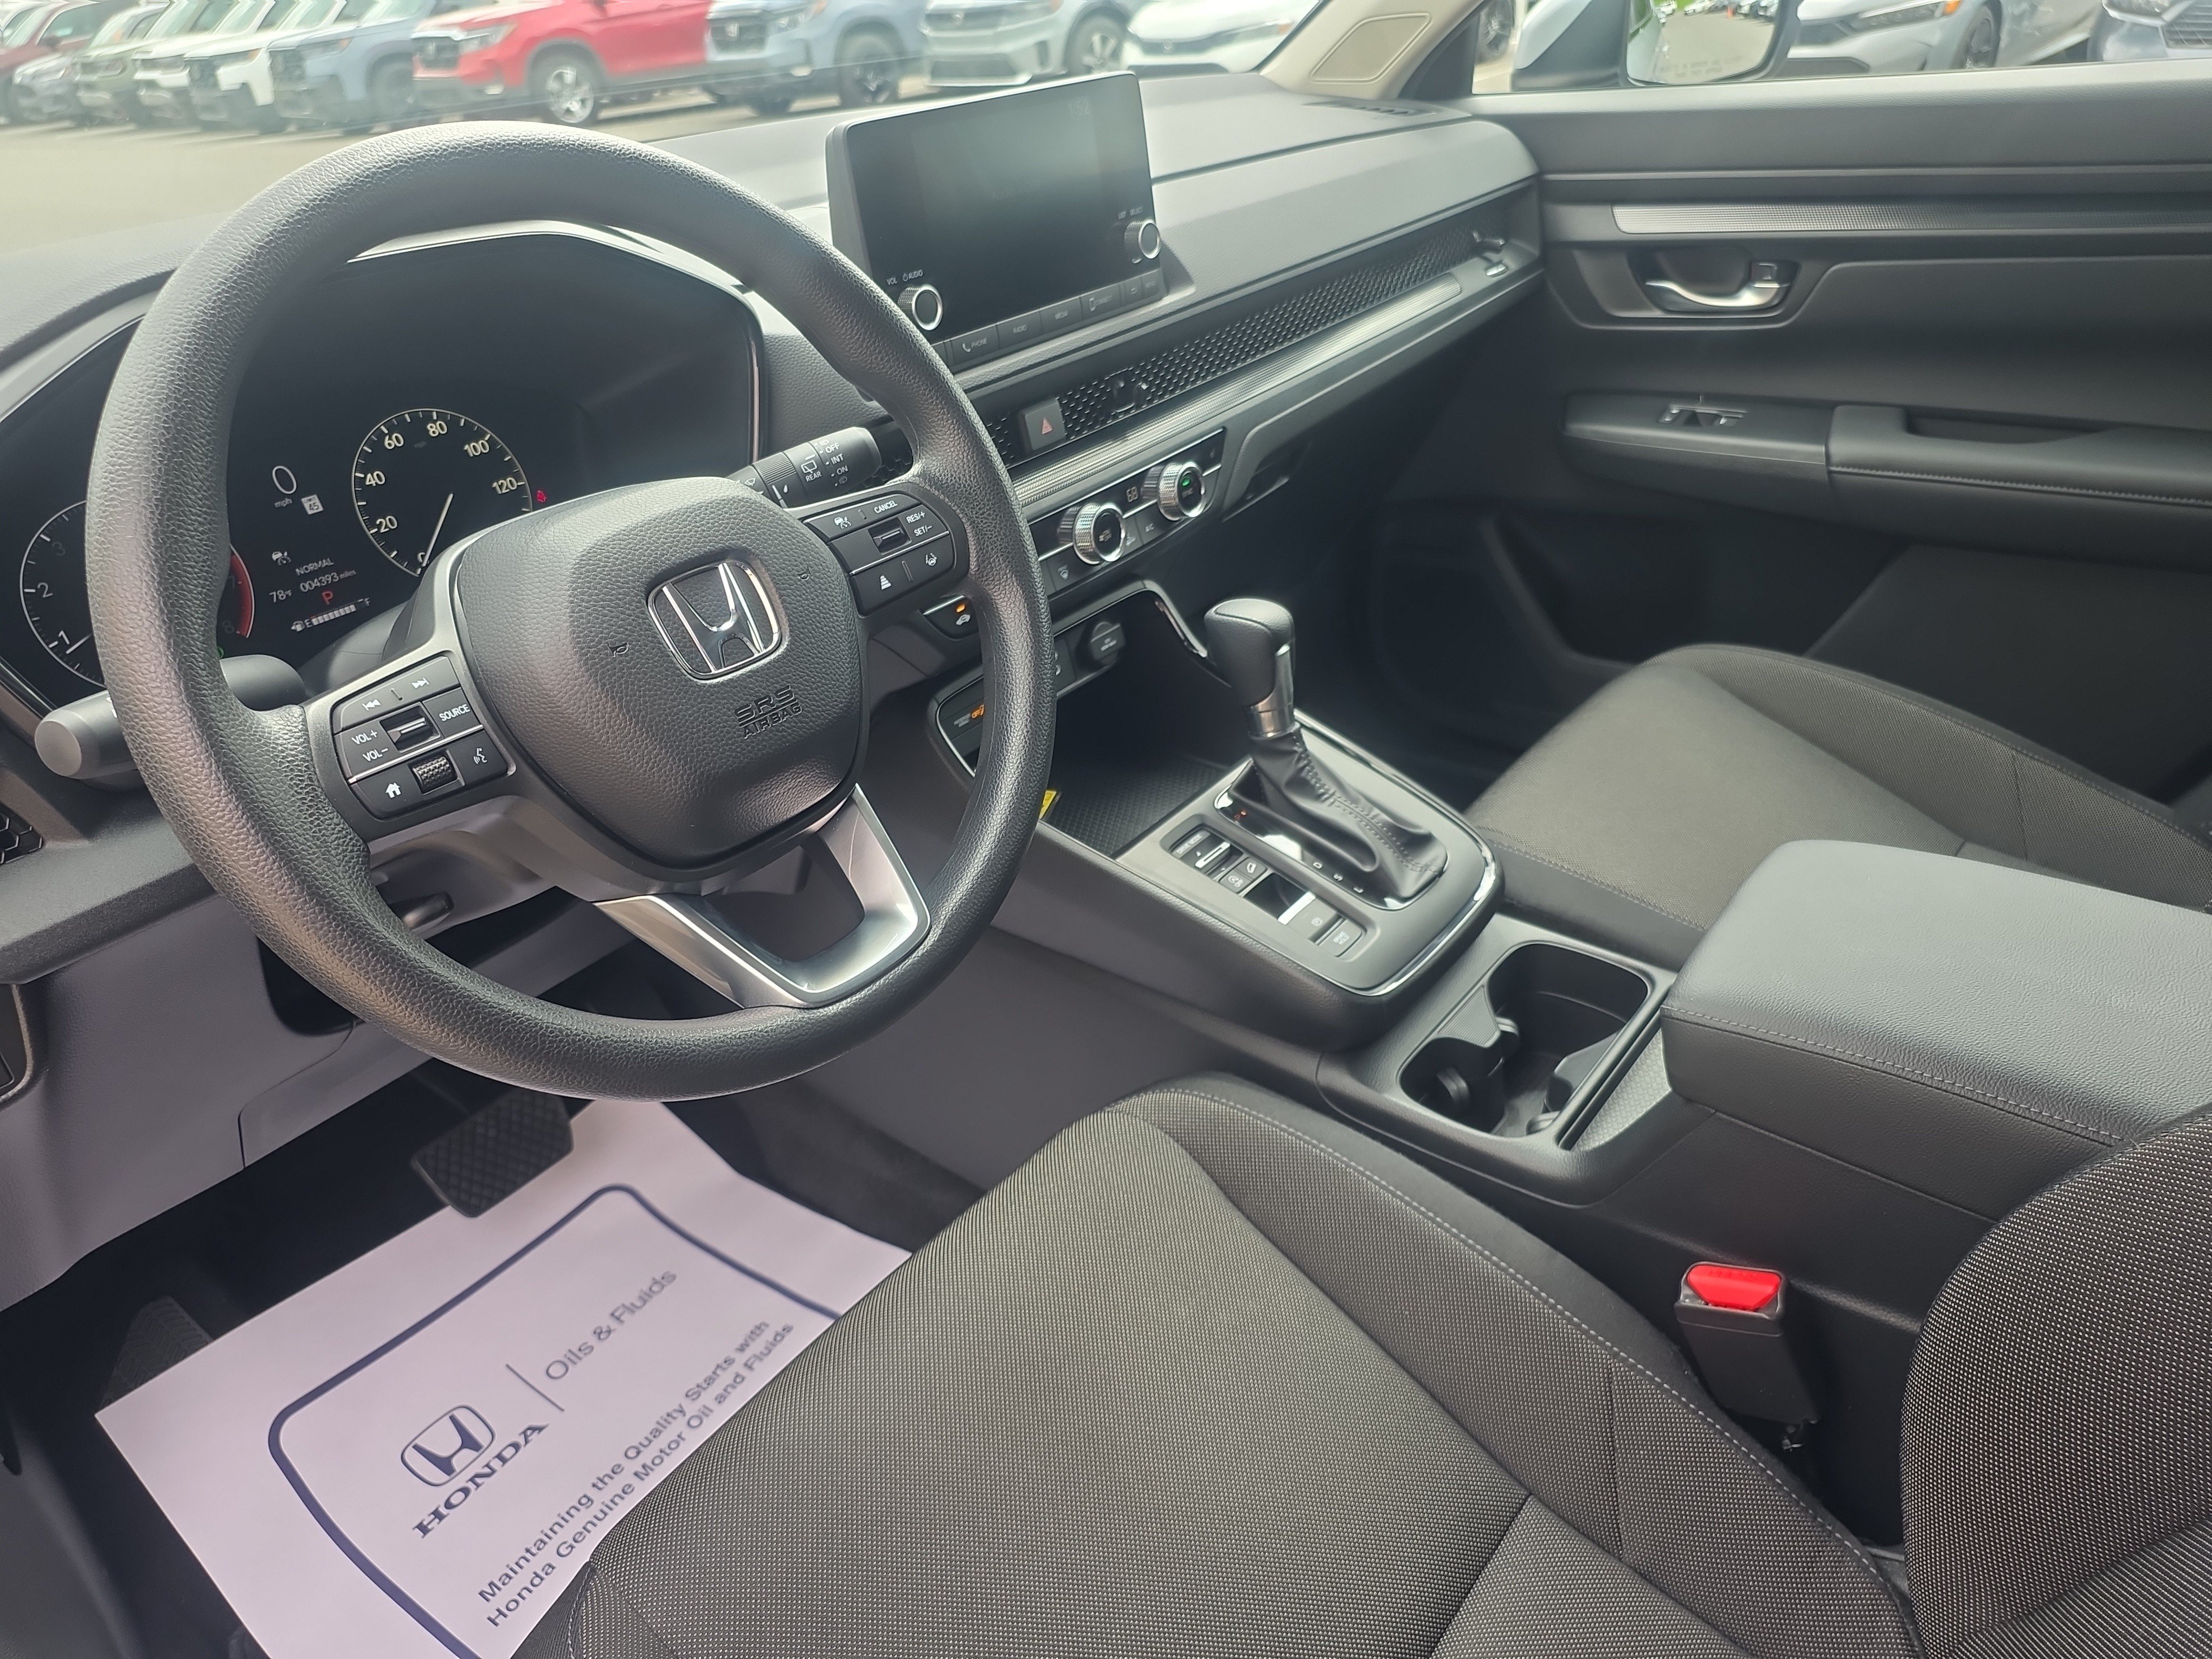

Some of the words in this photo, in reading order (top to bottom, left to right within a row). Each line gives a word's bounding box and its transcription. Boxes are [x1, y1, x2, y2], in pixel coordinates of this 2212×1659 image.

[972, 337, 987, 348] PHONE
[427, 421, 448, 437] 80
[383, 432, 404, 449] 60
[825, 442, 840, 453] OFF
[464, 440, 490, 458] 100
[831, 453, 844, 465] INT
[806, 471, 822, 483] REAR
[836, 465, 848, 475] ON
[272, 466, 297, 494] 0
[365, 471, 385, 487] 40
[492, 477, 518, 494] 120
[274, 498, 292, 507] mph
[308, 502, 319, 511] 45
[874, 500, 898, 514] CANCEL
[376, 516, 398, 533] 20
[906, 510, 926, 524] RES/+
[295, 557, 335, 576] NORMAL
[300, 572, 339, 592] 004393
[340, 570, 357, 579] miles
[37, 582, 53, 598] 2
[321, 590, 333, 606] P
[304, 619, 313, 628] E
[58, 630, 70, 645] 1
[734, 685, 797, 720] SRS
[439, 704, 470, 722] SOURCE
[743, 704, 803, 739] AIRBAG
[351, 729, 378, 745] VOL+
[546, 1341, 594, 1379] Oils
[593, 1324, 616, 1341] &
[610, 1270, 677, 1324] Fluids
[478, 1493, 594, 1603] Maintaining
[591, 1463, 624, 1491] the
[625, 1403, 687, 1460] Quality
[685, 1356, 736, 1400] Starts
[735, 1321, 769, 1353] with
[412, 1423, 550, 1539] HONDA
[486, 1562, 557, 1628] Honda
[556, 1482, 635, 1558] Genuine
[633, 1431, 686, 1482] Motor
[687, 1405, 715, 1429] Oil
[715, 1371, 747, 1404] and
[743, 1323, 794, 1371] Fluids
